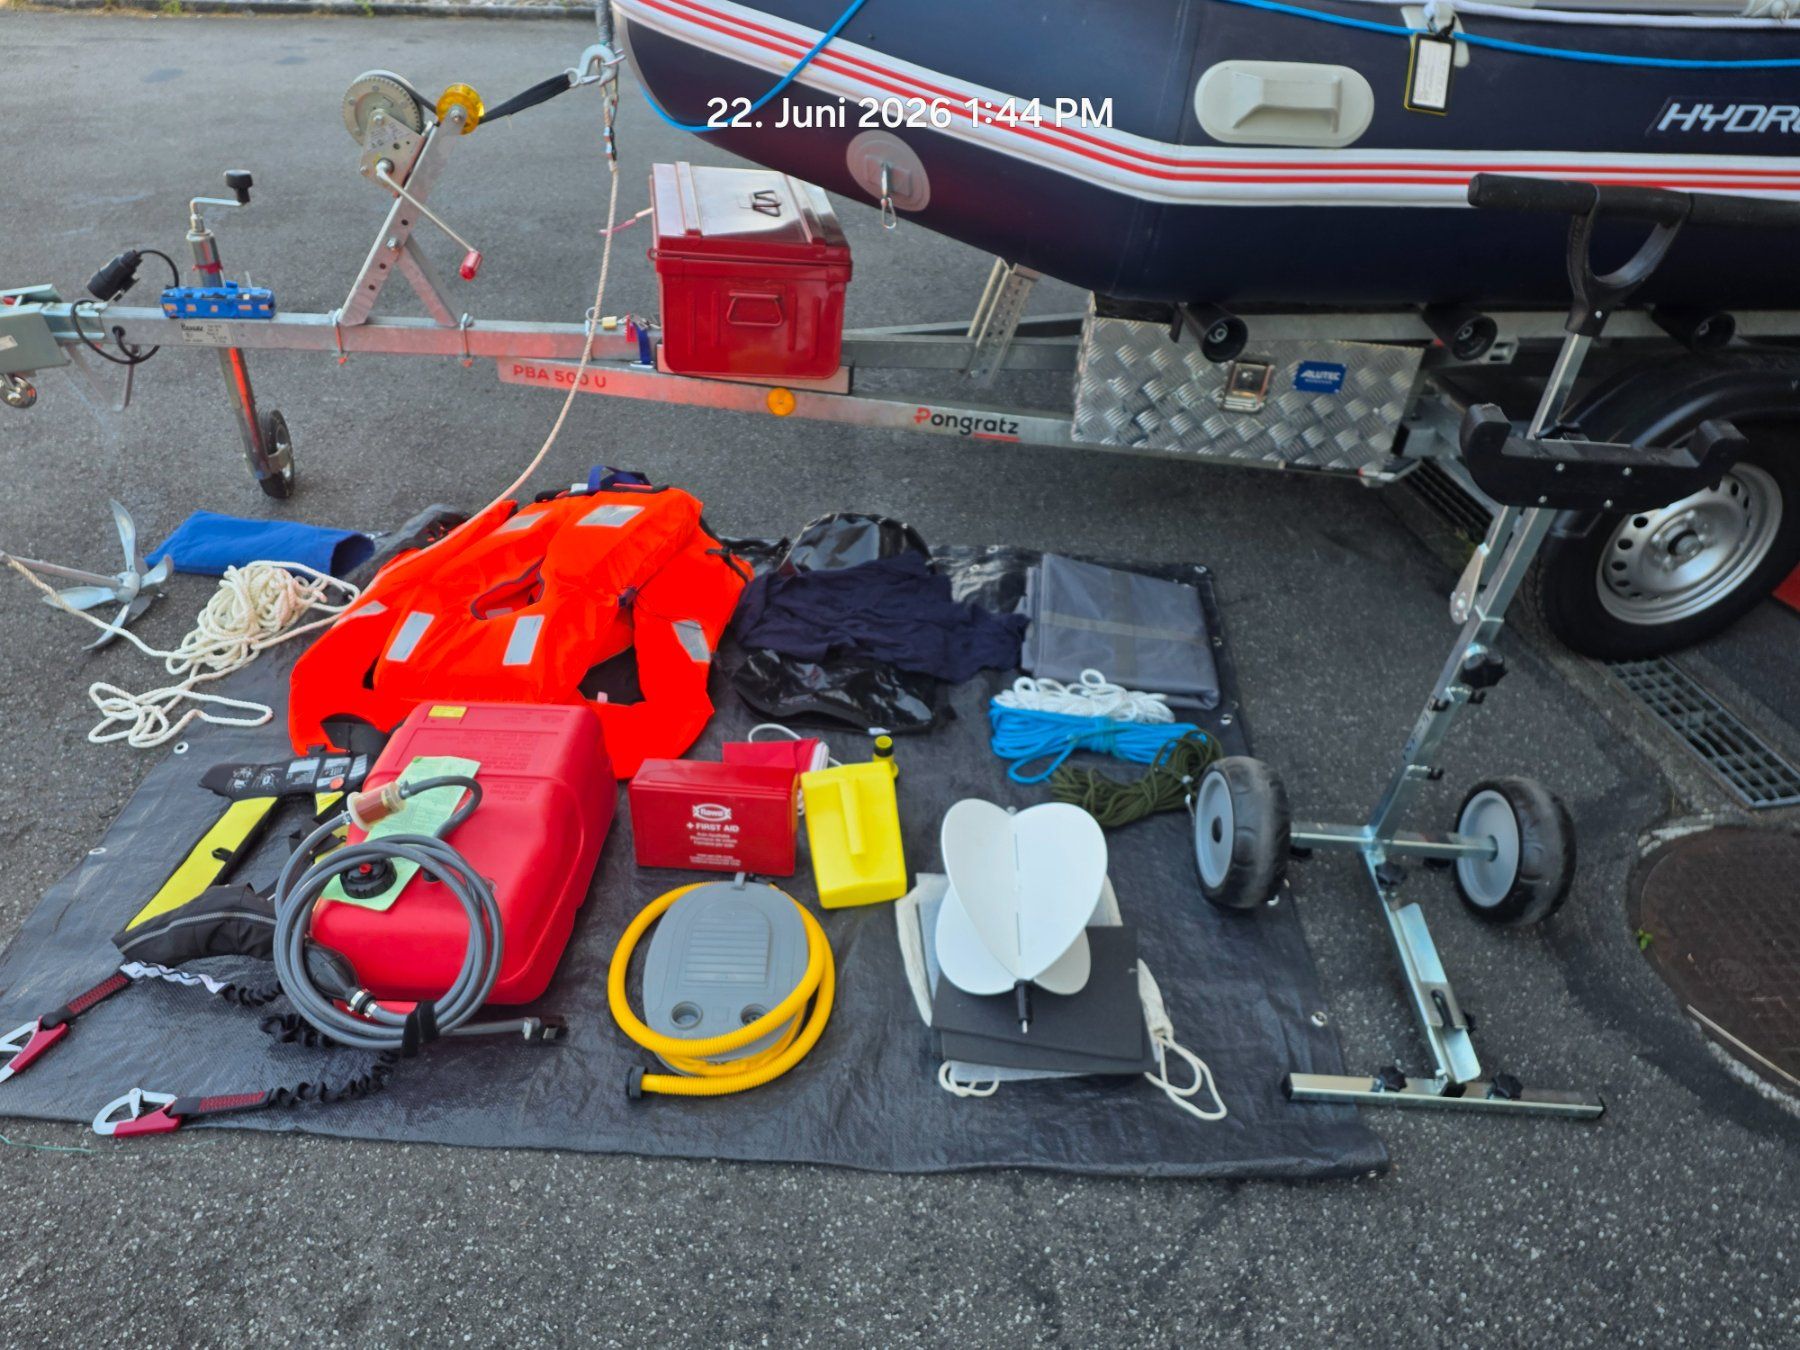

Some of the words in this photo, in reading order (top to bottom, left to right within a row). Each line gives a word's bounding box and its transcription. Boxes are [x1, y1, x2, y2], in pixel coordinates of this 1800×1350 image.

[1657, 102, 1800, 133] HYDR
[513, 364, 550, 381] PBA
[554, 370, 590, 386] 500
[594, 375, 607, 389] U
[914, 407, 1019, 436] Pongratz
[696, 822, 721, 831] FIRST
[724, 824, 739, 832] AID
